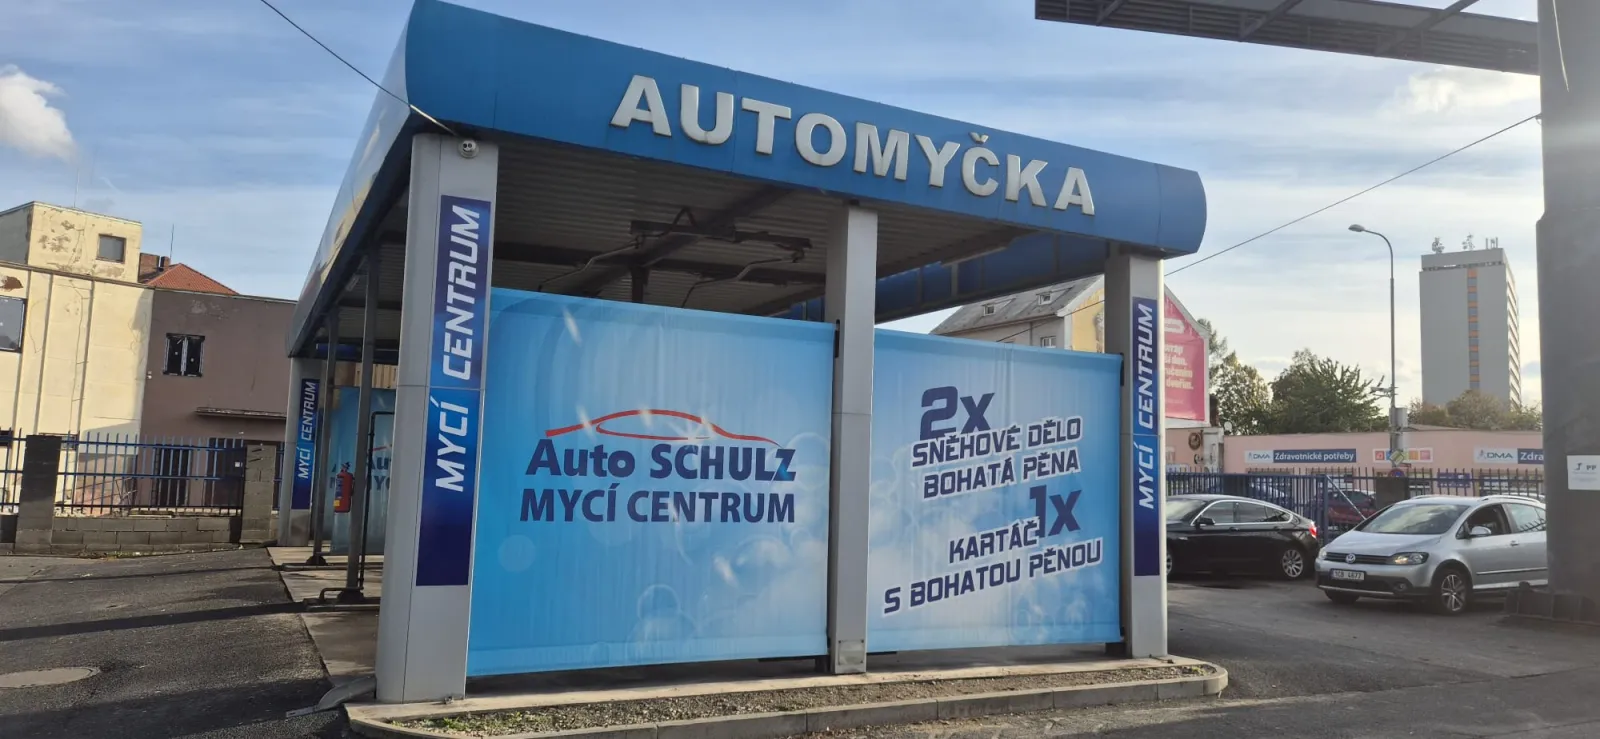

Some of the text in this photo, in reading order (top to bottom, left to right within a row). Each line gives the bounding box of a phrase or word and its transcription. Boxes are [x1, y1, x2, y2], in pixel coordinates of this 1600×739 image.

[609, 74, 1096, 216] AUTOMYČKA
[430, 204, 480, 492] MYCÍ CENTRUM
[296, 381, 316, 479] MYCÍ CENTRUM
[920, 386, 995, 440] 2x
[1133, 303, 1154, 509] MYCÍ CENTRUM
[525, 438, 796, 482] Auto SCHULZ
[912, 417, 1081, 467] SNĚHOVÉ DĚLO
[1274, 452, 1322, 461] Zdravotnické
[1323, 451, 1354, 462] potřeby
[924, 449, 1079, 499] BOHATÁ PĚNA
[520, 482, 795, 523] MYCÍ CENTRUM
[1030, 485, 1082, 538] 1x
[949, 520, 1038, 564] KARTÁČ
[884, 540, 1101, 614] S BOHATOU PĚNOU
